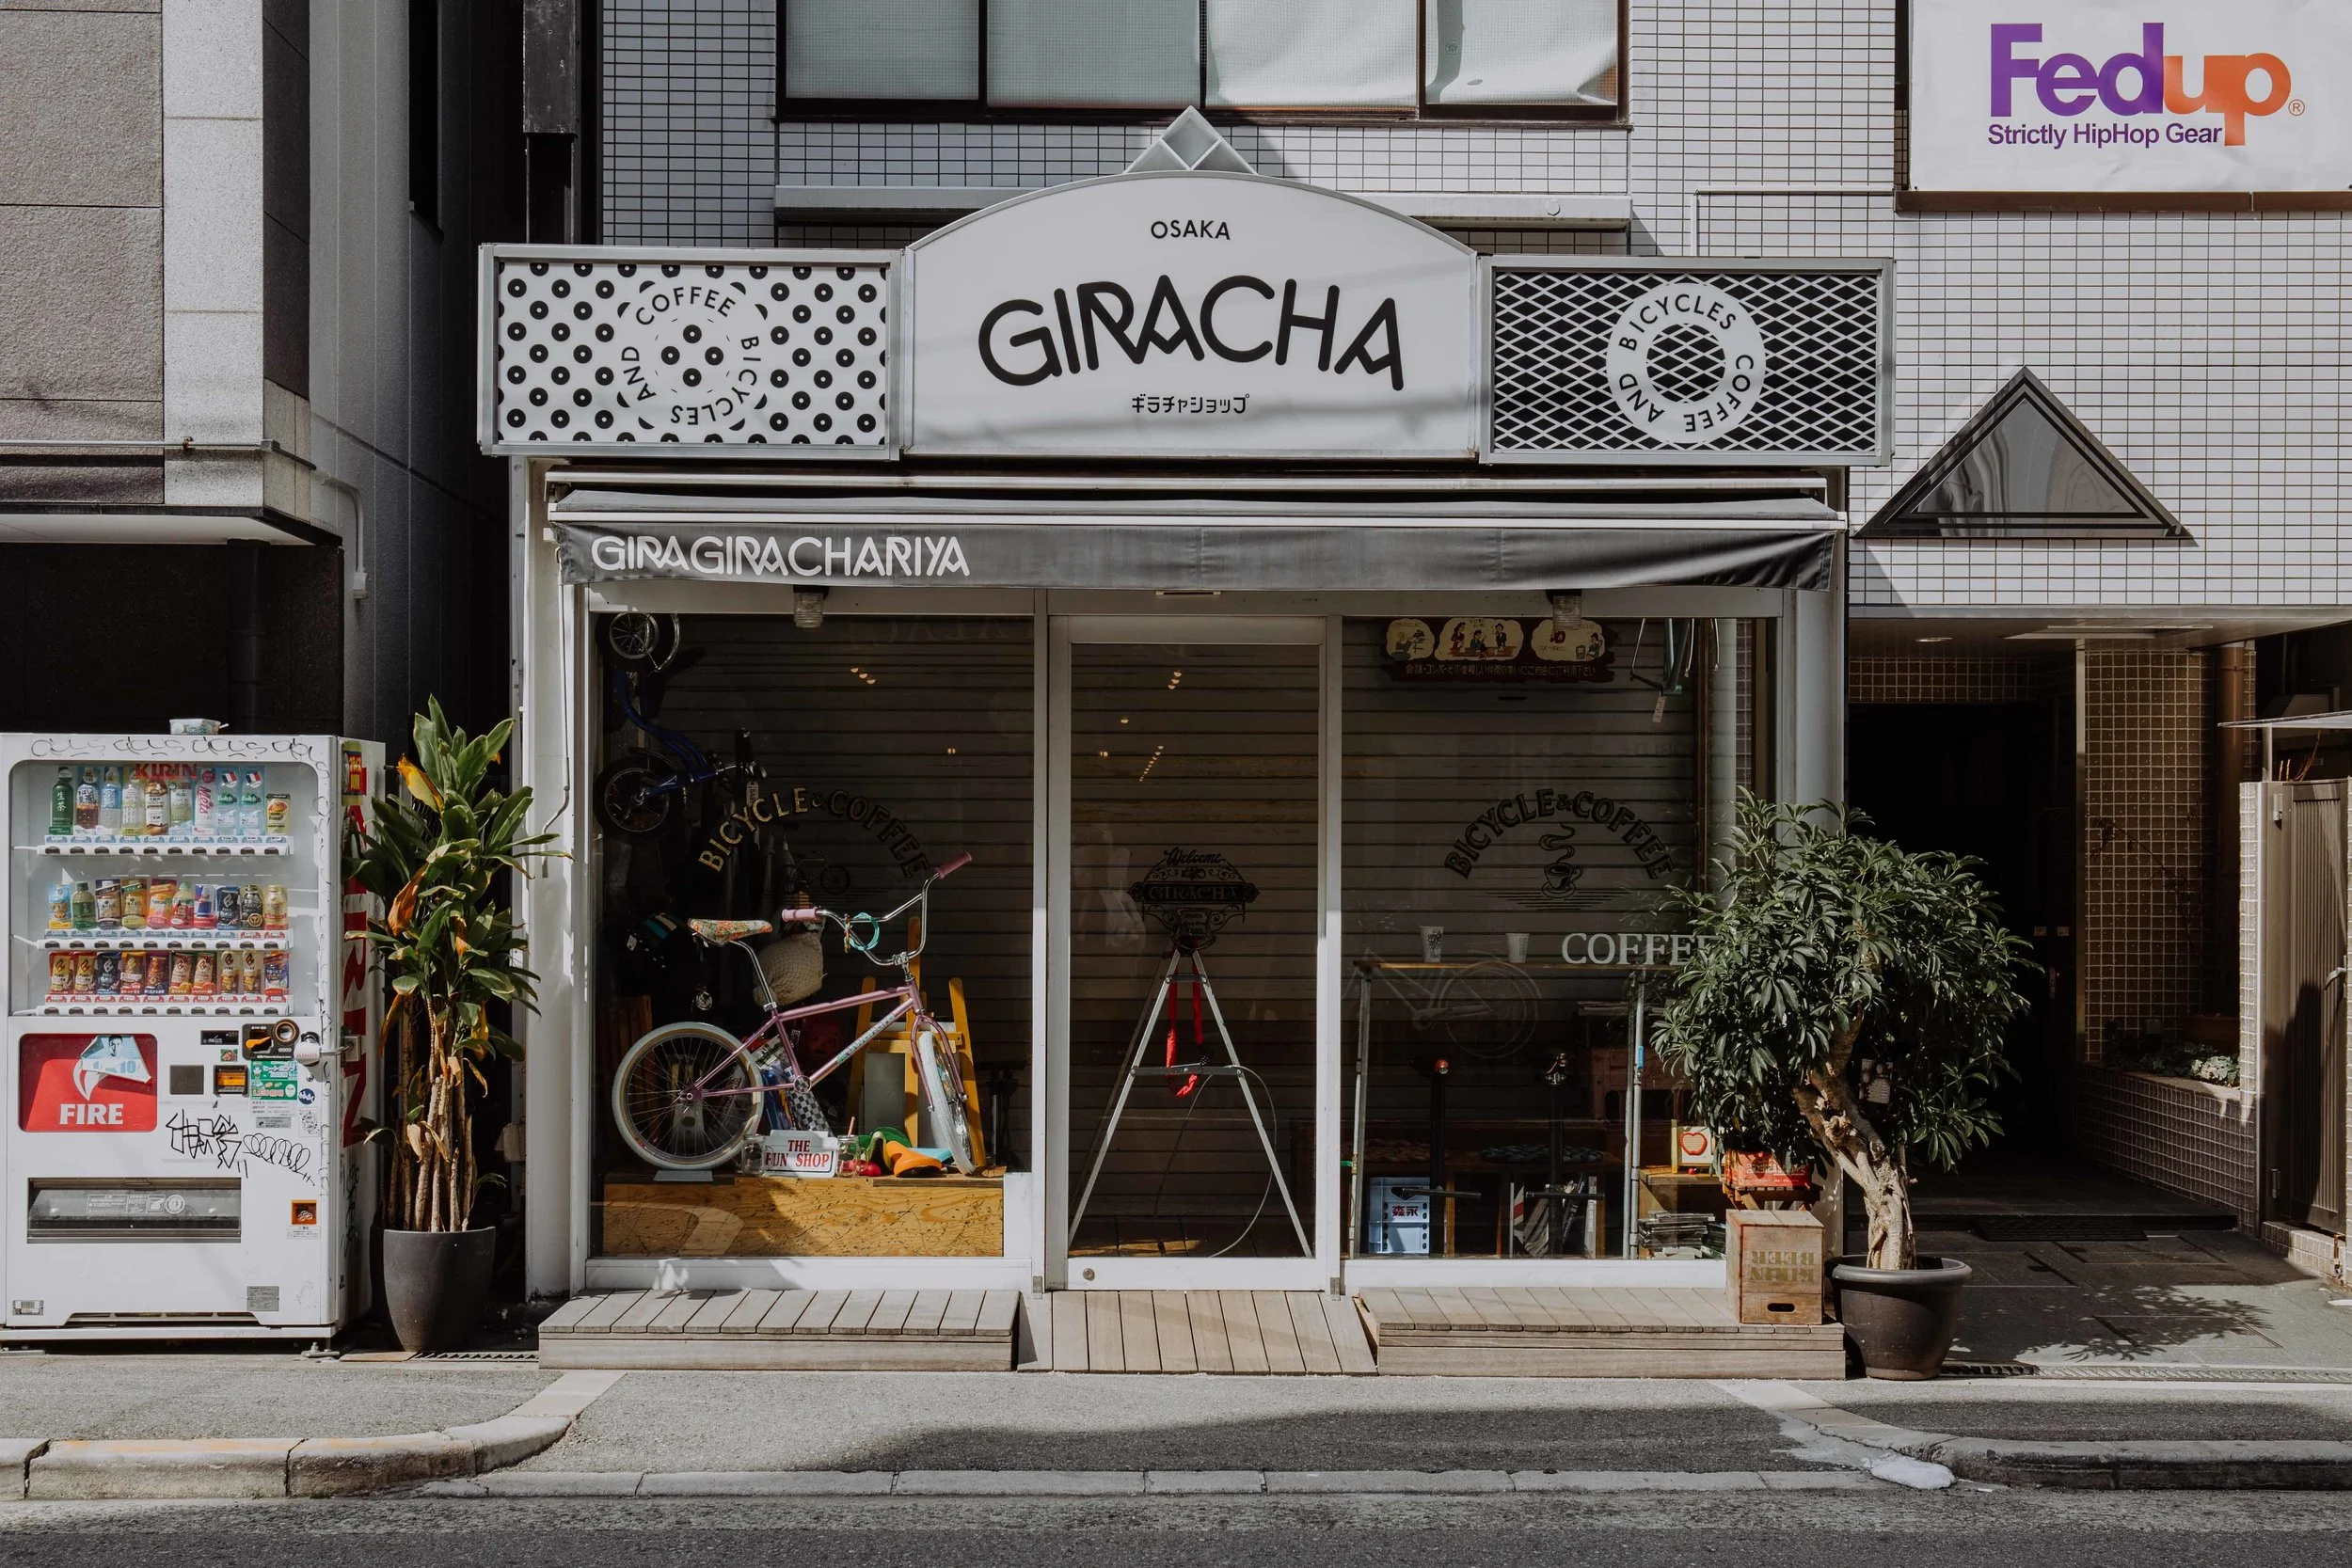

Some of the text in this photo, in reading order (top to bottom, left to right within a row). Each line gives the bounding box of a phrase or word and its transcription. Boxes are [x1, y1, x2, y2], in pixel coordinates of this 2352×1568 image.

[1988, 122, 2222, 149] Strictly HipHop Gear
[1151, 219, 1231, 241] OSAKA
[978, 275, 1405, 391] GIRACHA
[621, 285, 761, 425] COFFEE BICYCLES AND
[1619, 293, 1754, 433] BICYCLES COFFEE AND
[1131, 393, 1250, 415] ギラチャショップ
[135, 763, 197, 780] KIRIN
[56, 791, 67, 812] 生茶
[697, 786, 809, 873] BICYCLE
[828, 789, 930, 879] COFFEE
[1444, 788, 1554, 879] BICYCLE
[1572, 791, 1677, 880] COFFEE
[1163, 847, 1227, 866] Welcome
[1148, 885, 1239, 901] GIRACHA
[59, 1103, 124, 1125] FIRE
[787, 1140, 811, 1152] THE
[796, 1153, 829, 1167] SHOP
[1751, 1251, 1815, 1266] BEER
